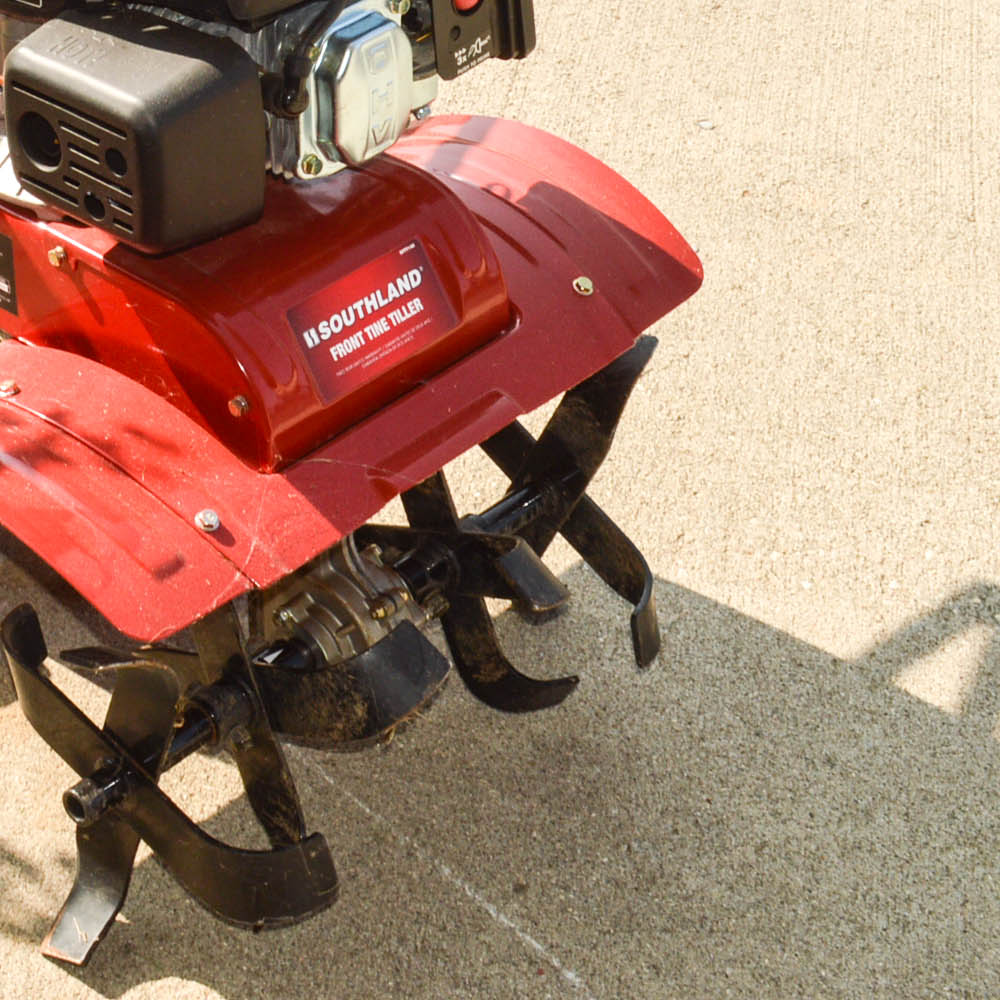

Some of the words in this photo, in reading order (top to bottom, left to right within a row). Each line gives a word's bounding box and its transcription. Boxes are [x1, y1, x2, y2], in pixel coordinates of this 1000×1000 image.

[317, 267, 423, 341] SOUTHLAND
[329, 330, 366, 362] FRONT
[364, 316, 391, 341] TINE
[387, 297, 425, 327] TILLER
